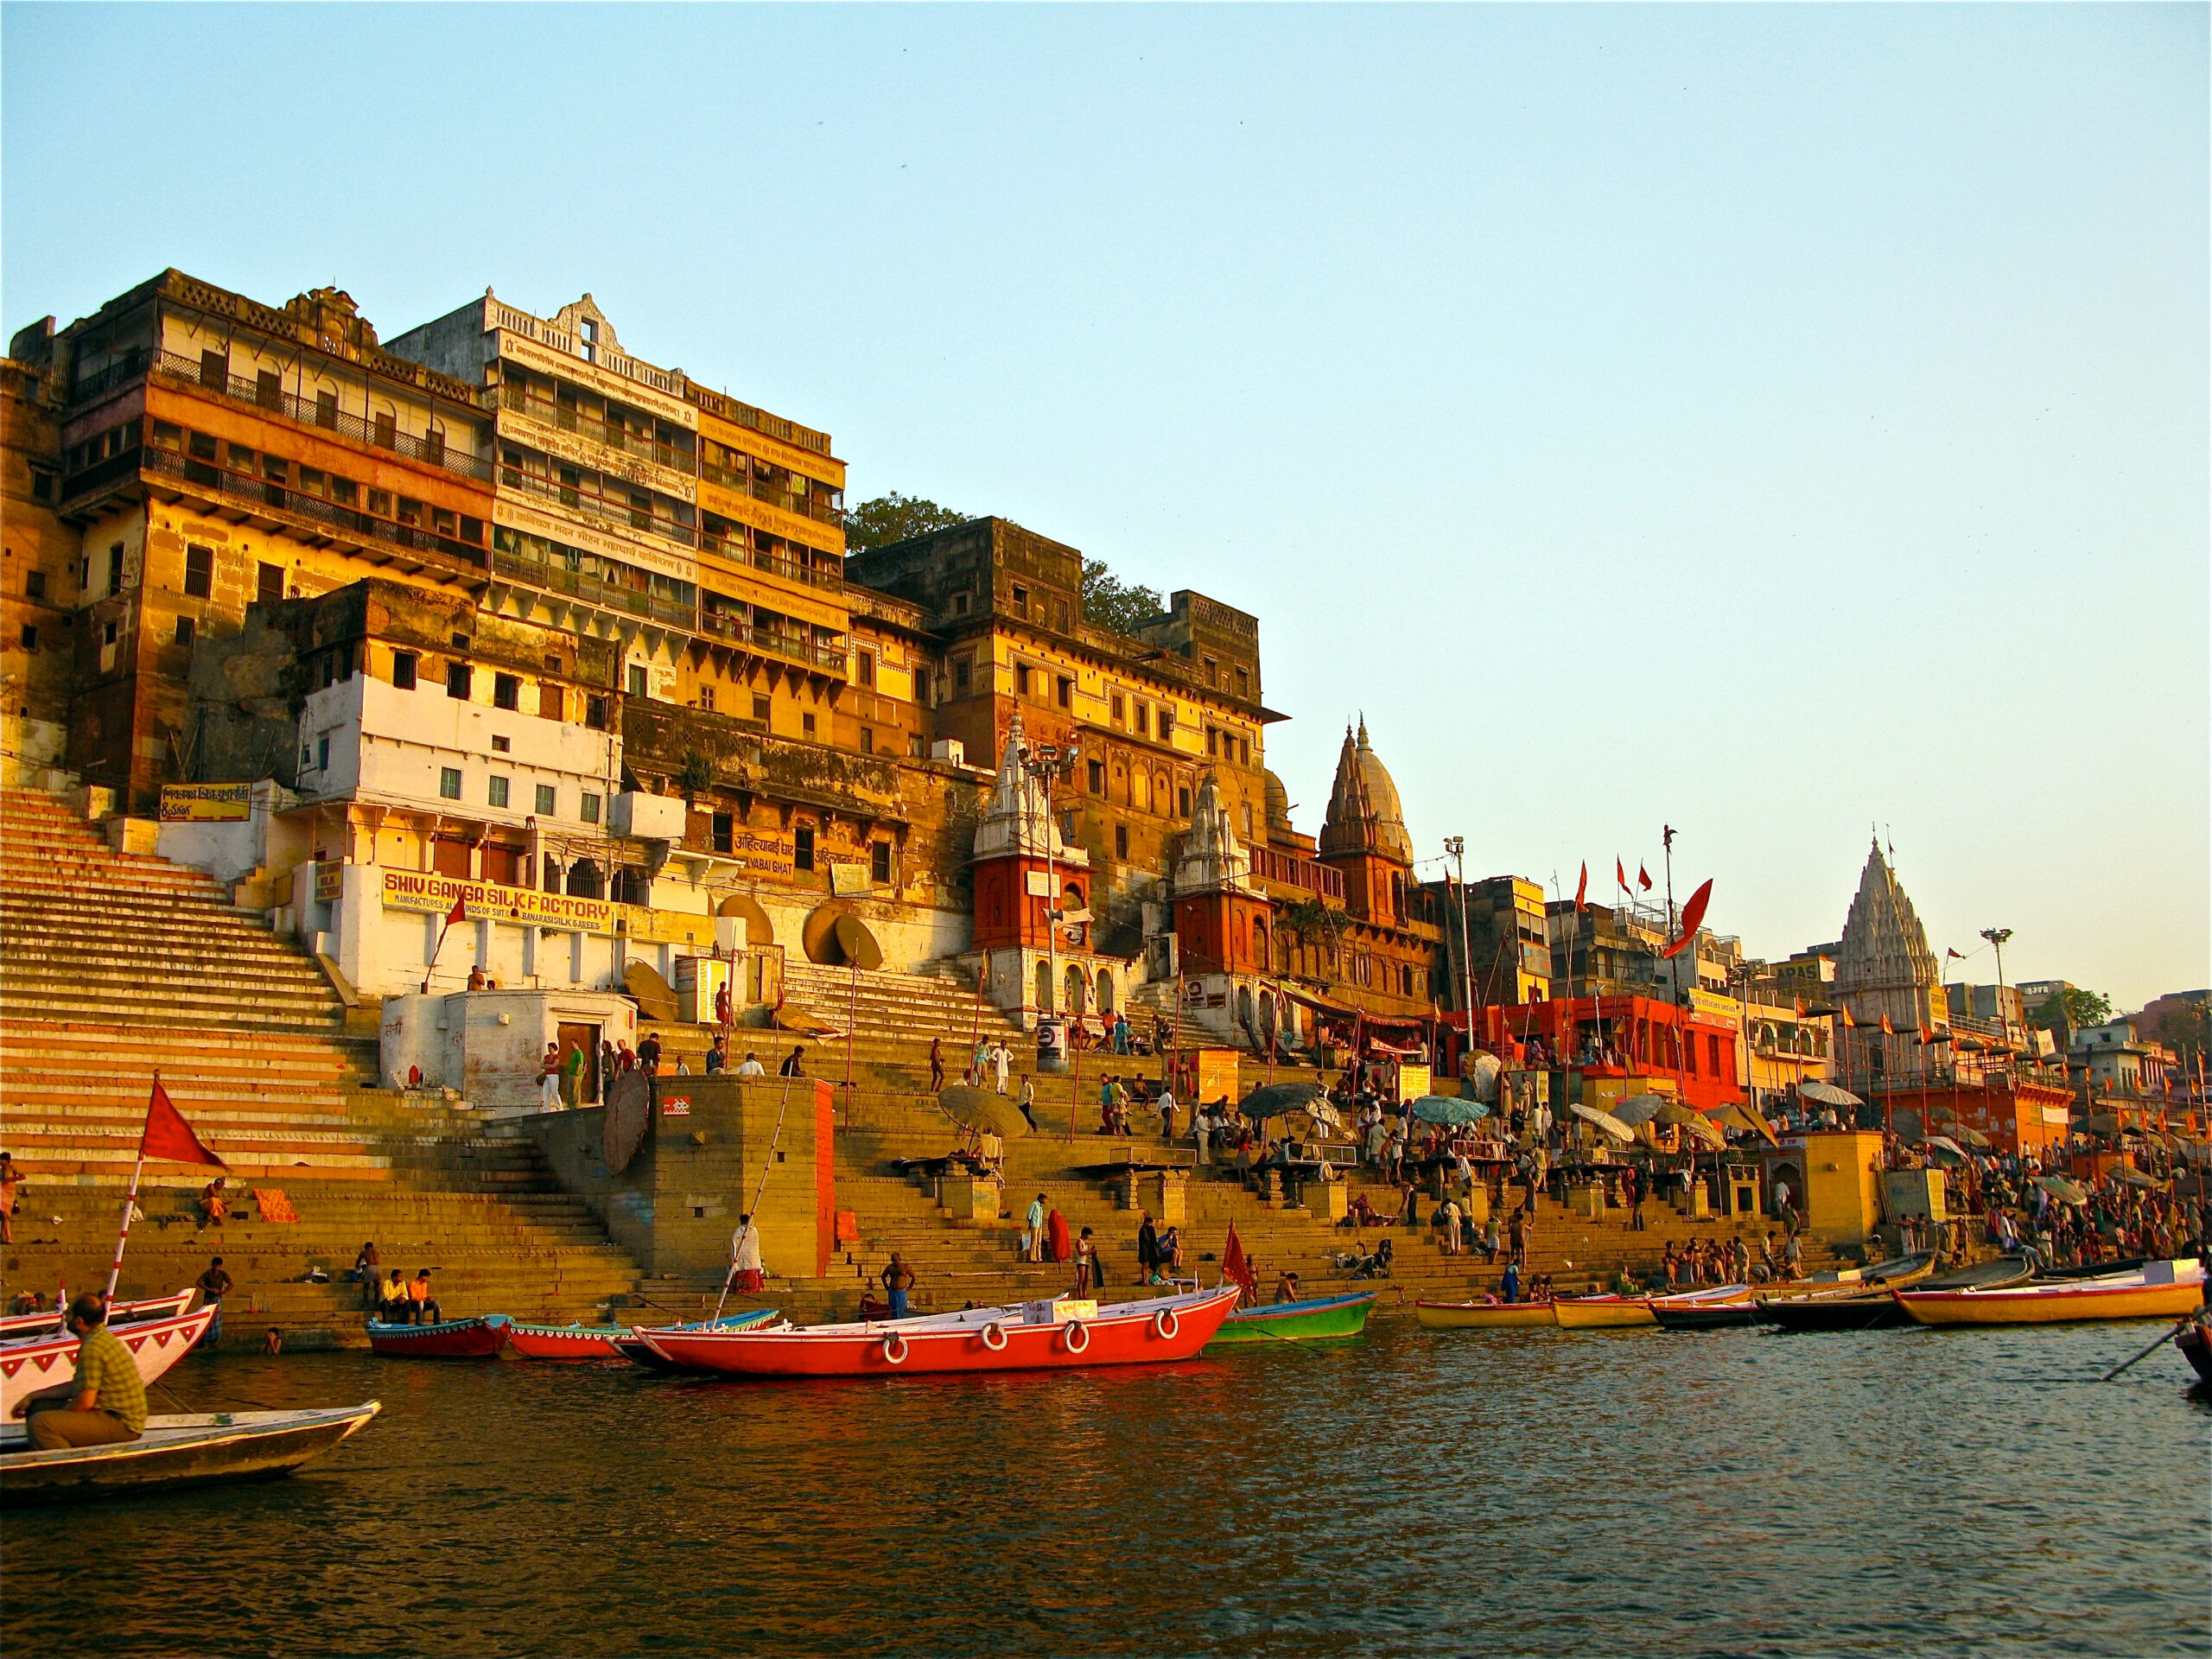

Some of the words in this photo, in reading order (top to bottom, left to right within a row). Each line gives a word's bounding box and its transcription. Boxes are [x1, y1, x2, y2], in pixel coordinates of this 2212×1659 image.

[734, 832, 780, 856] अहिल्याबाई
[780, 842, 794, 856] घाट
[772, 861, 792, 875] GHAT
[385, 873, 425, 894] SHIV
[428, 880, 485, 903] GANGA
[486, 888, 526, 909] SILK
[527, 894, 610, 920] FACTORY
[394, 894, 443, 909] MANUFACTURES
[465, 905, 481, 914] INDS
[481, 906, 491, 915] OF
[493, 908, 505, 918] SUIT
[521, 912, 553, 924] BANARASI
[553, 916, 571, 927] SILK
[573, 919, 601, 931] SAREES
